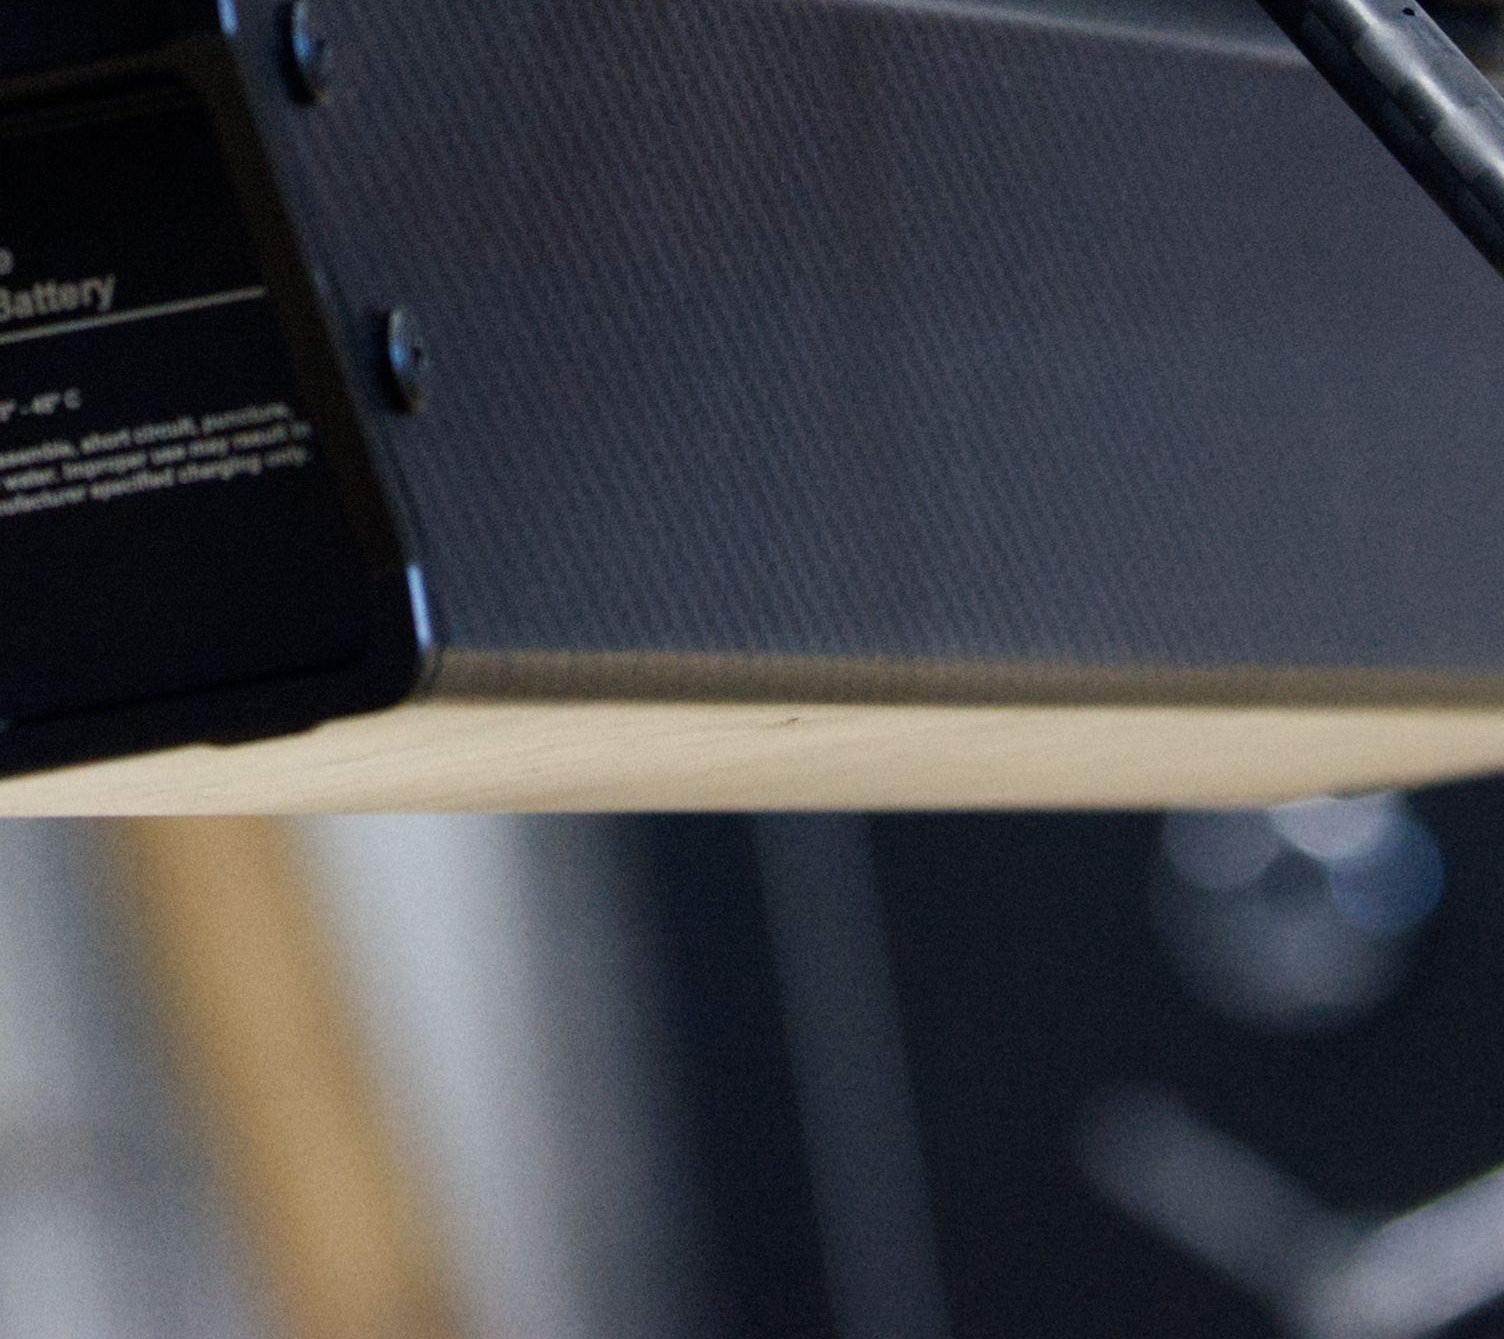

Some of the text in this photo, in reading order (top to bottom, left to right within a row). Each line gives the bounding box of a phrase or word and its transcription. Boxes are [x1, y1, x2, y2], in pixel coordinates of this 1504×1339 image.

[80, 428, 131, 454] short
[150, 445, 186, 466] use
[189, 437, 228, 460] may
[177, 454, 262, 483] charging
